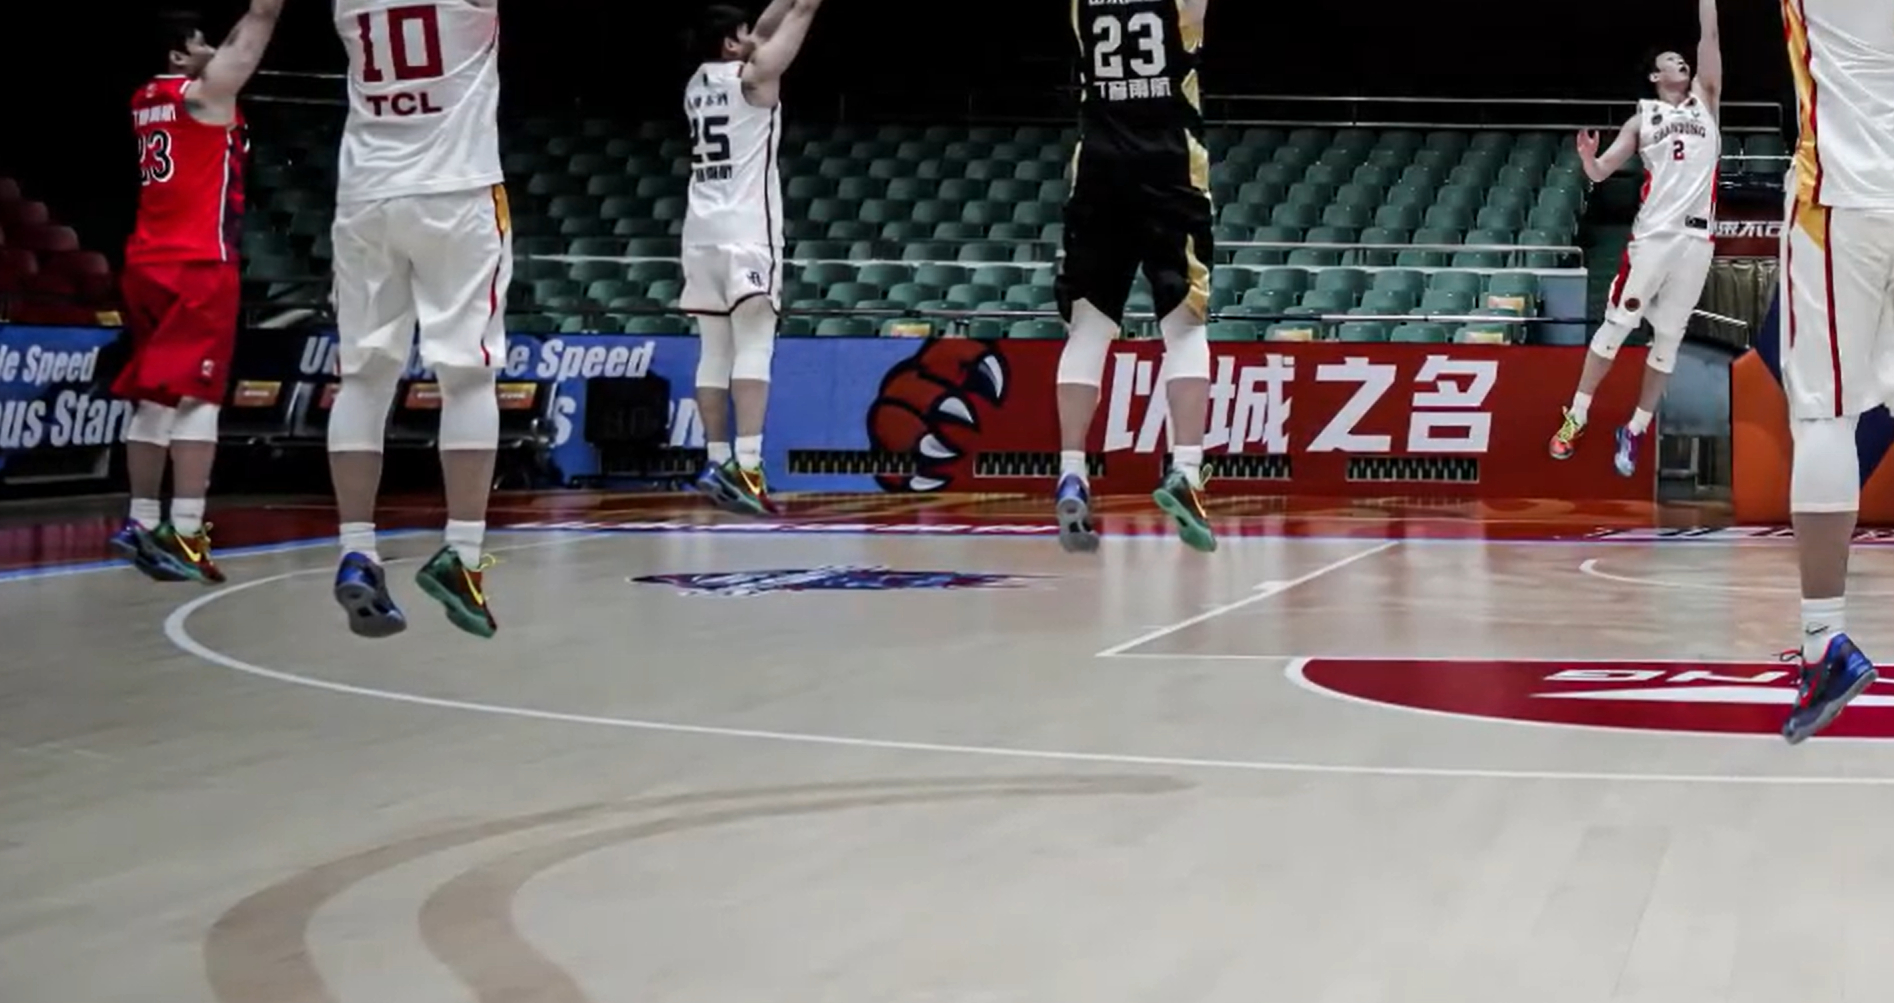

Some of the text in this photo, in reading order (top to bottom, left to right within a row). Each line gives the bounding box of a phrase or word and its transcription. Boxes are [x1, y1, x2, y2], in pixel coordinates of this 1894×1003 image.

[357, 4, 444, 82] 10
[1092, 11, 1167, 78] 23
[366, 92, 443, 116] TCL
[1673, 139, 1685, 161] 2
[22, 344, 100, 386] Speed
[536, 338, 655, 379] Speed
